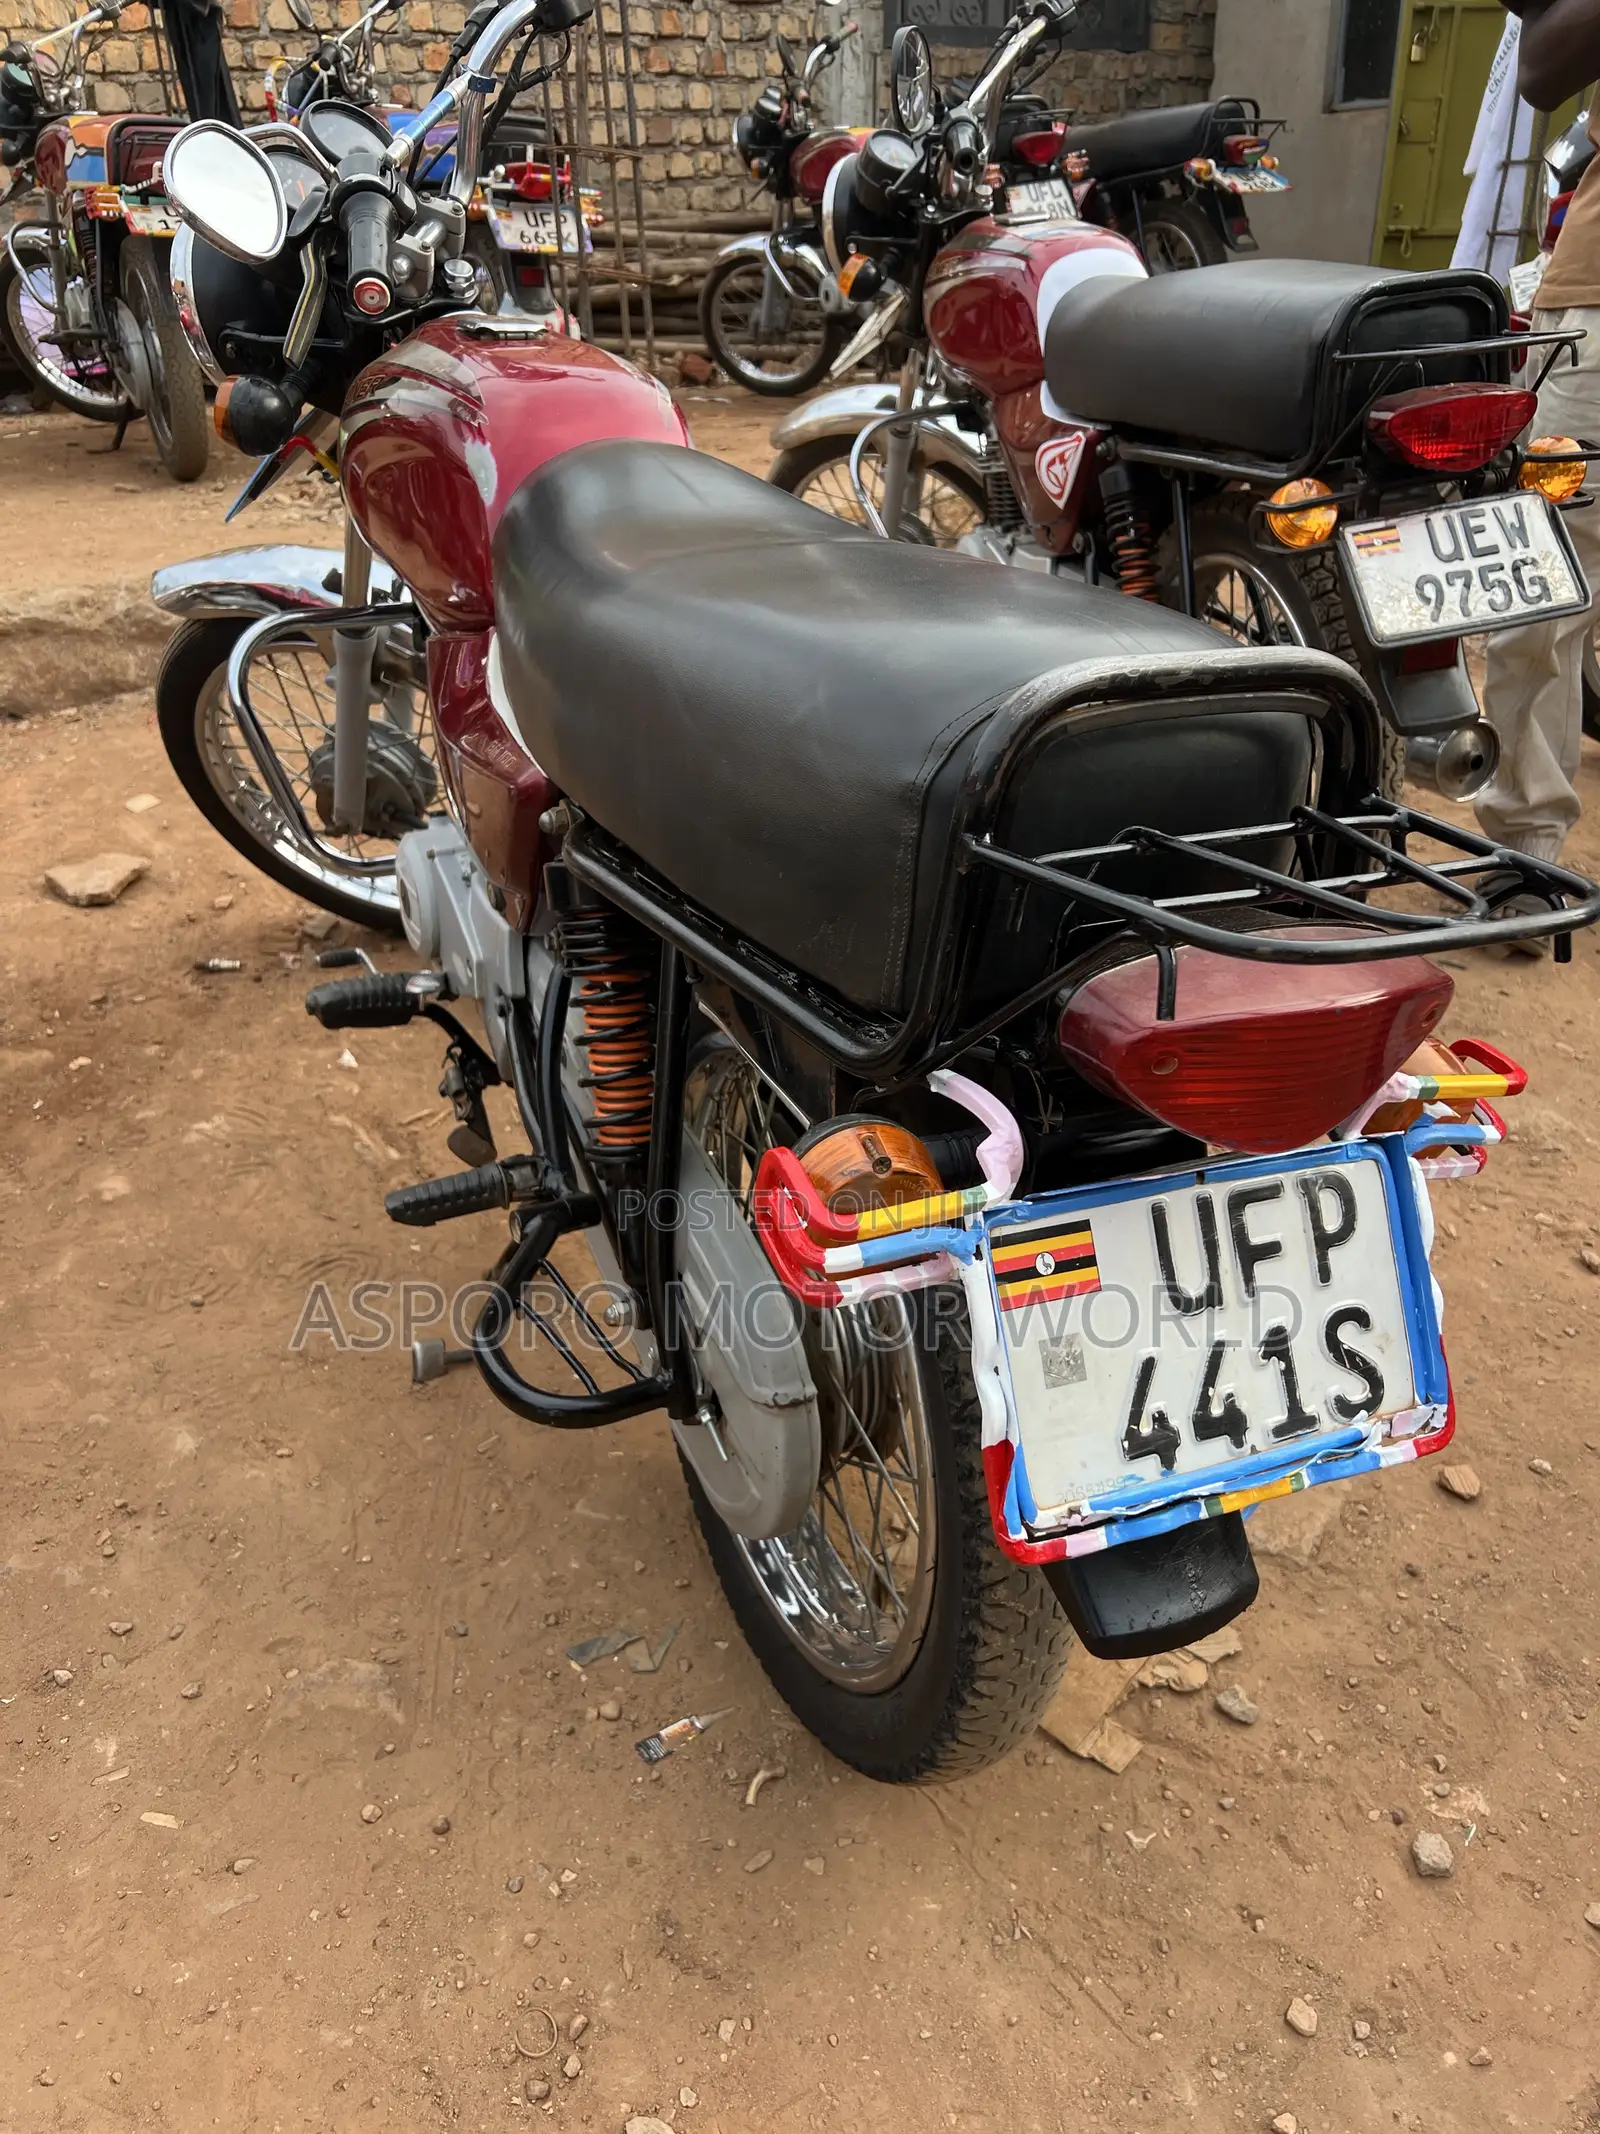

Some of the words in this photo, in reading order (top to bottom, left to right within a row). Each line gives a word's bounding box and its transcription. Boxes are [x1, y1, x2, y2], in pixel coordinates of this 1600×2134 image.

[1425, 502, 1531, 563] UEW
[1415, 556, 1553, 622] 975G
[1151, 1172, 1357, 1316] UFP
[1121, 1305, 1385, 1471] 441S
